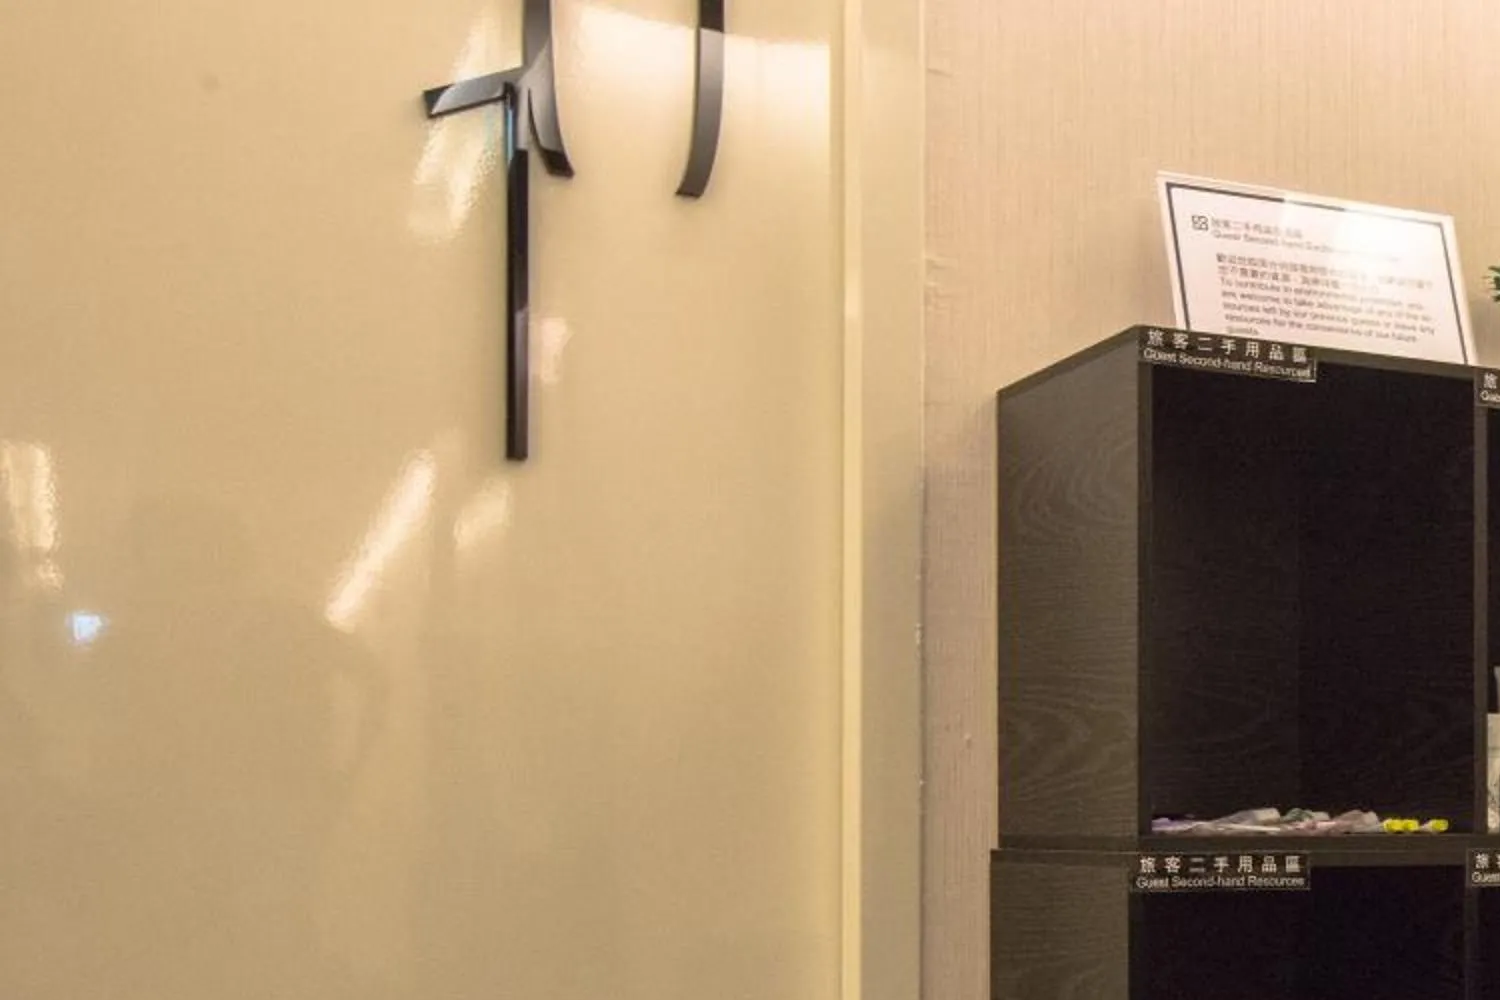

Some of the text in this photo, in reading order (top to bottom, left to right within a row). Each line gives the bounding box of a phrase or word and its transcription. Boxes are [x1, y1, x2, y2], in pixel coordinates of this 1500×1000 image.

[1143, 348, 1176, 363] Guest
[1136, 875, 1305, 888] Guest Second-hand Resources
